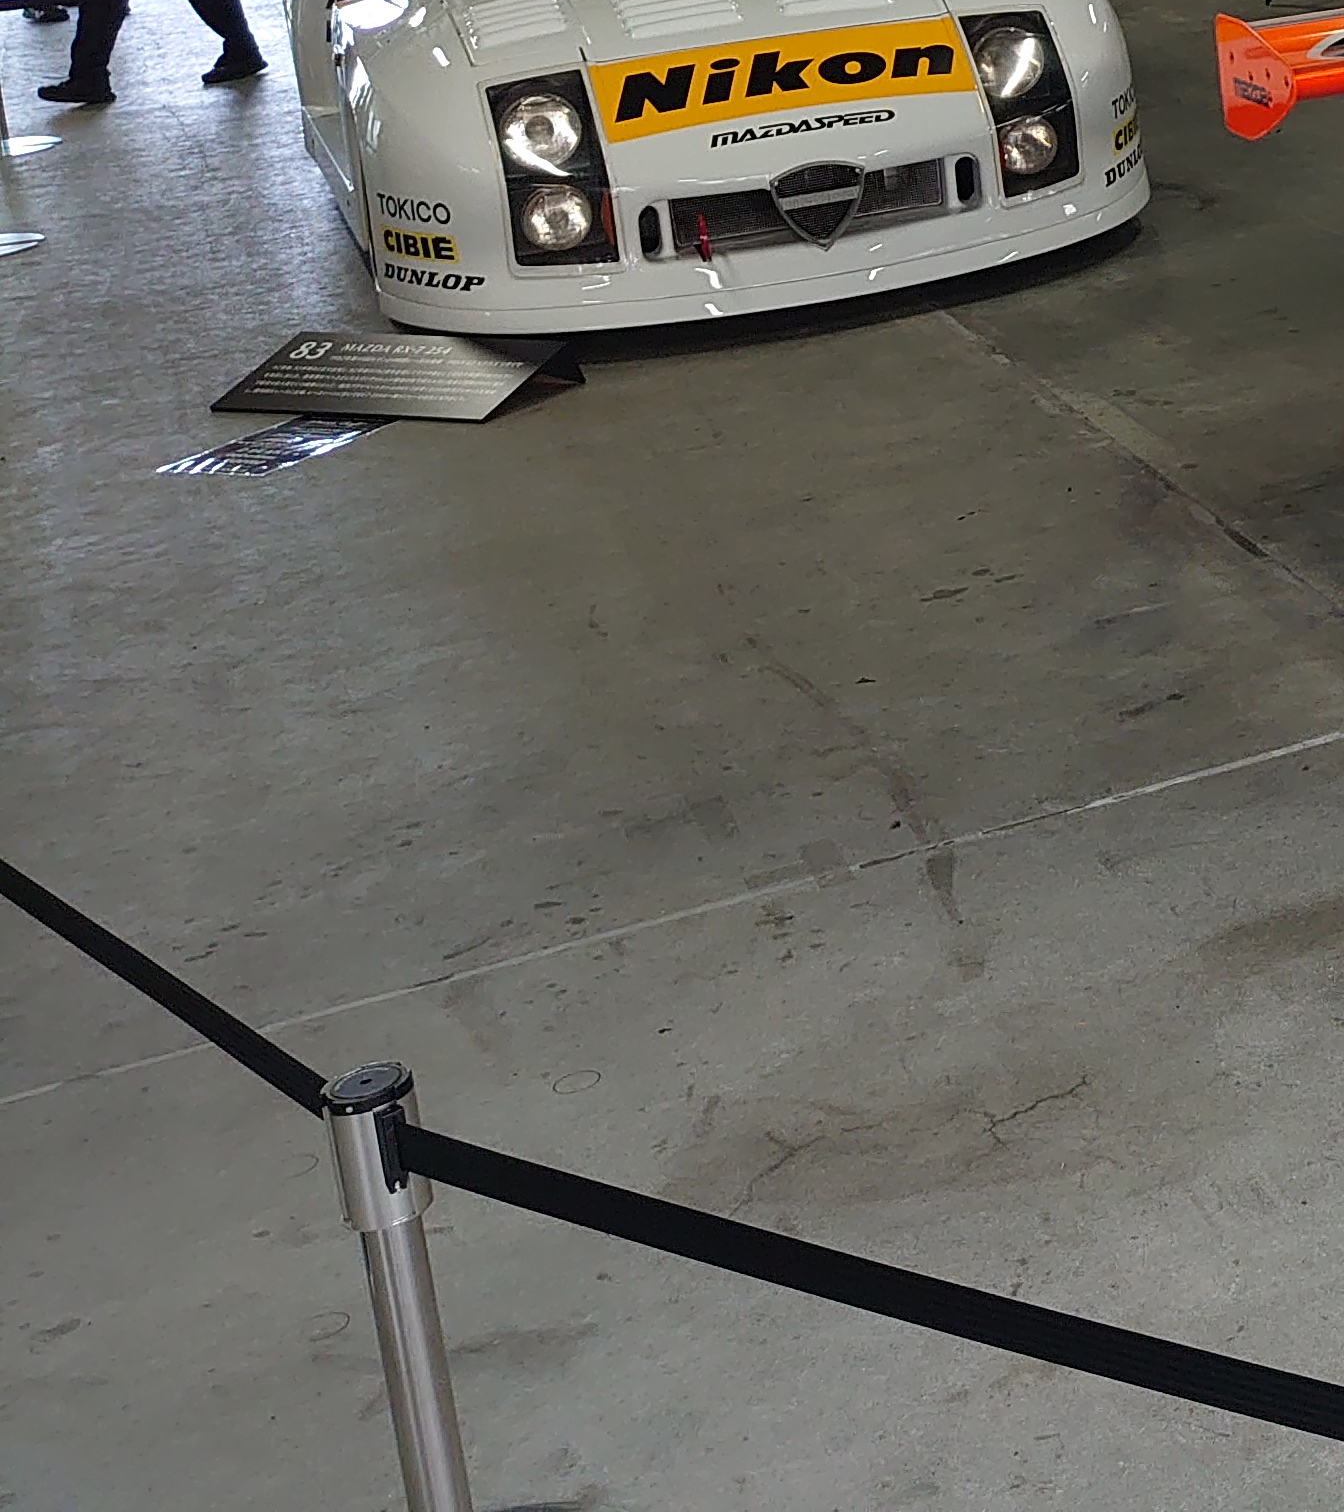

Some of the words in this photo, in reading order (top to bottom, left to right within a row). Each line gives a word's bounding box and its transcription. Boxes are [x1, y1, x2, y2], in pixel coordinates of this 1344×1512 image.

[615, 43, 955, 123] Nikon
[710, 109, 895, 149] MAZDASPEED
[376, 192, 452, 225] TOKICO
[384, 262, 485, 292] DUNLOP
[289, 341, 332, 360] 83
[339, 343, 391, 355] MAZDA
